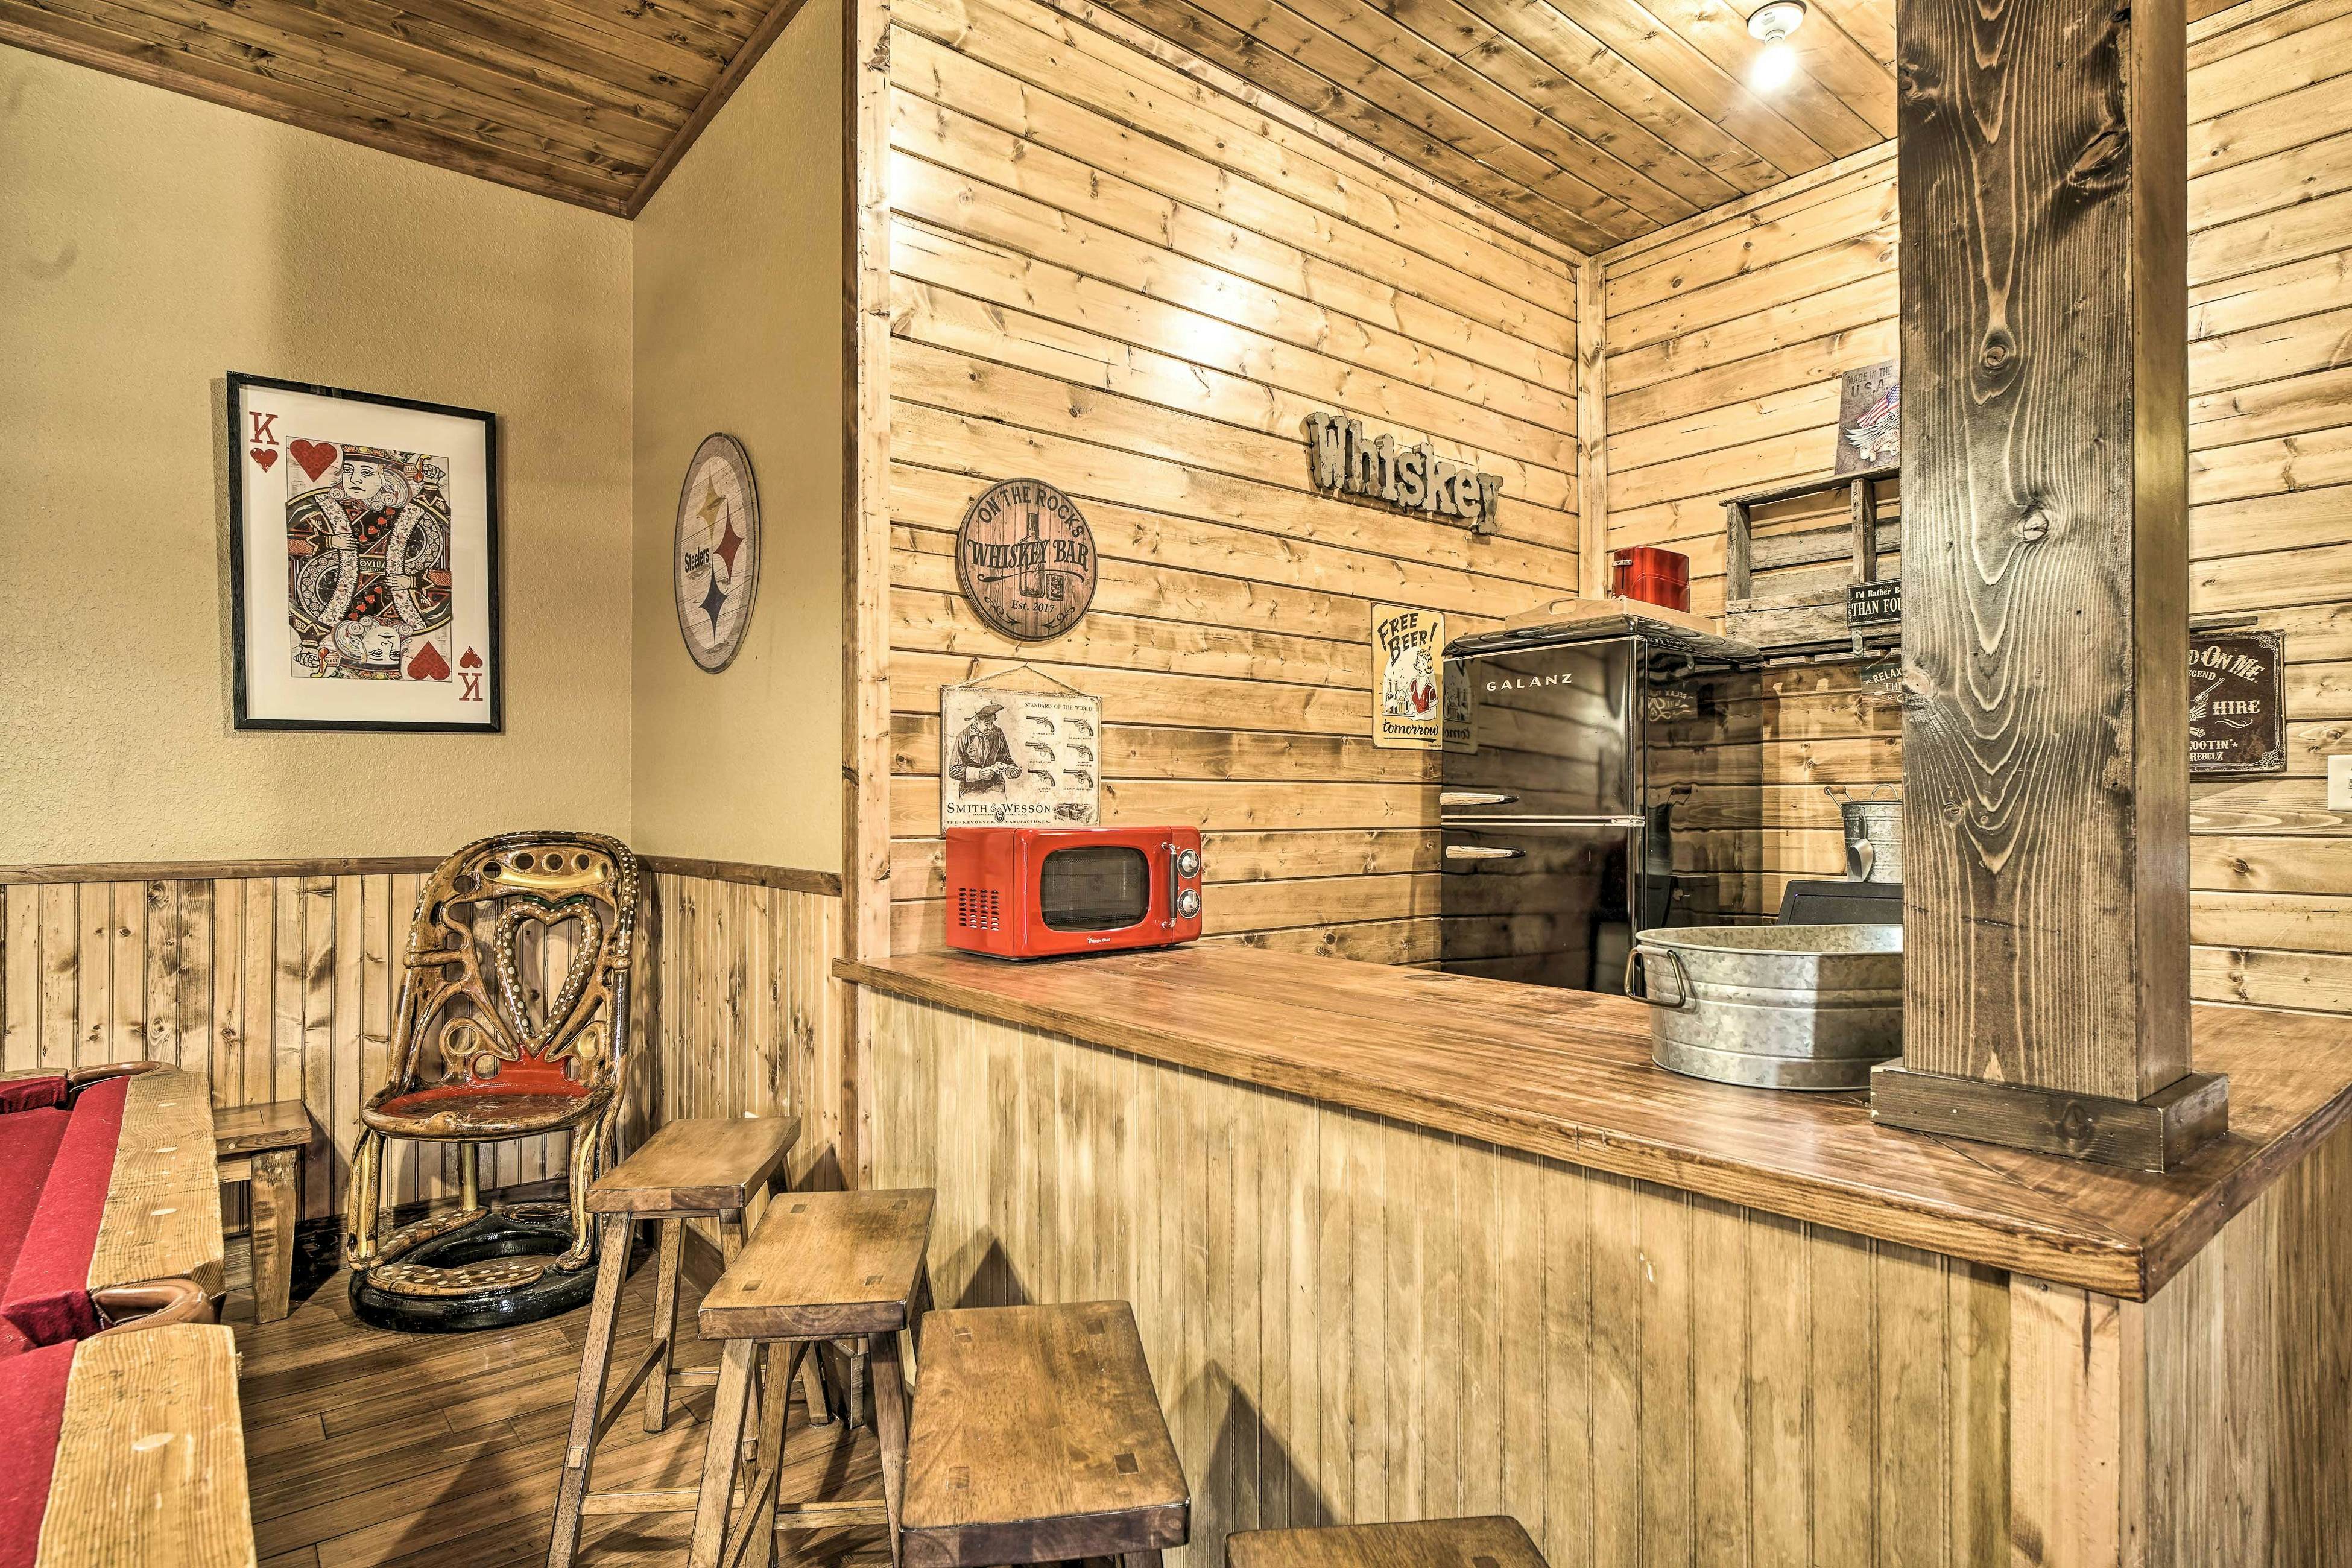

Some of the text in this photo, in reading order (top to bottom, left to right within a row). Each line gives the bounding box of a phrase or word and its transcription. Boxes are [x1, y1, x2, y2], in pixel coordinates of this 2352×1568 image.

[1847, 372, 1868, 385] MADE
[1879, 366, 1892, 376] THE
[248, 411, 279, 446] K
[1306, 411, 1503, 535] Whiskey
[978, 485, 1085, 538] ON THE ROCKS
[684, 546, 709, 573] Steelers
[967, 538, 1089, 572] WHISKEY BAR
[1868, 589, 1891, 597] Rather
[1011, 599, 1055, 613] Est. 2017
[1851, 600, 1879, 616] THAN
[1377, 613, 1438, 667] FREE BEER!
[2201, 645, 2234, 670] ON
[1486, 674, 1573, 692] GALANZ
[1872, 668, 1902, 683] RELAX
[458, 672, 484, 701] K
[2212, 700, 2260, 715] HIRE
[1382, 719, 1439, 736] tomorrow
[947, 803, 1051, 814] SMITH & WESSON
